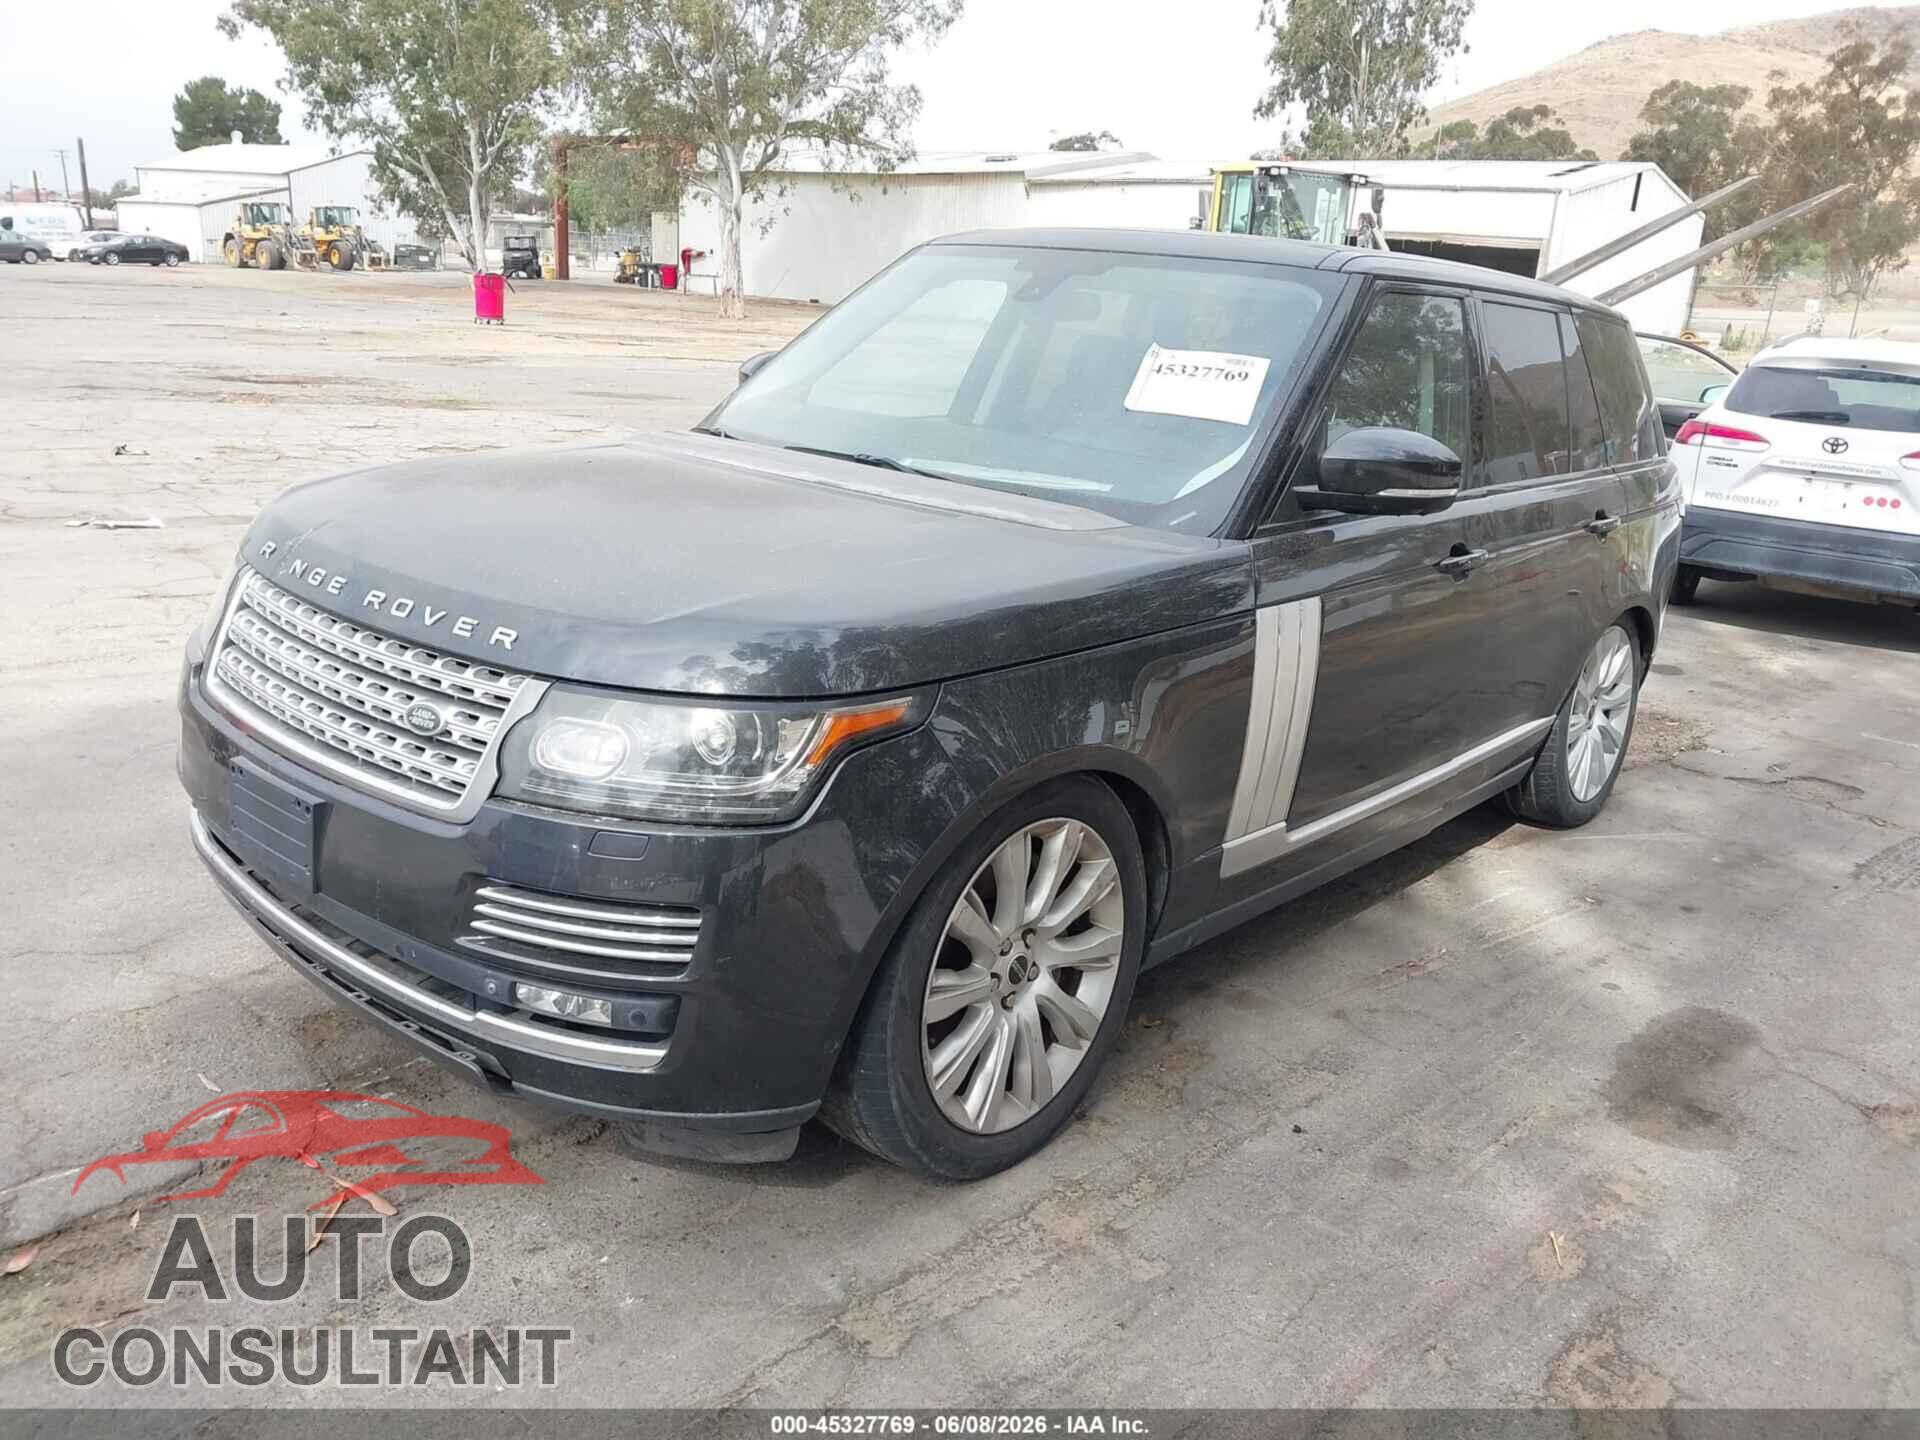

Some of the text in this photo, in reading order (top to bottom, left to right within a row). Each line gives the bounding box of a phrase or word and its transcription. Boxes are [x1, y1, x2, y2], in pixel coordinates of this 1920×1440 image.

[1151, 363, 1249, 382] 45327769
[259, 540, 520, 650] RNGE ROVER
